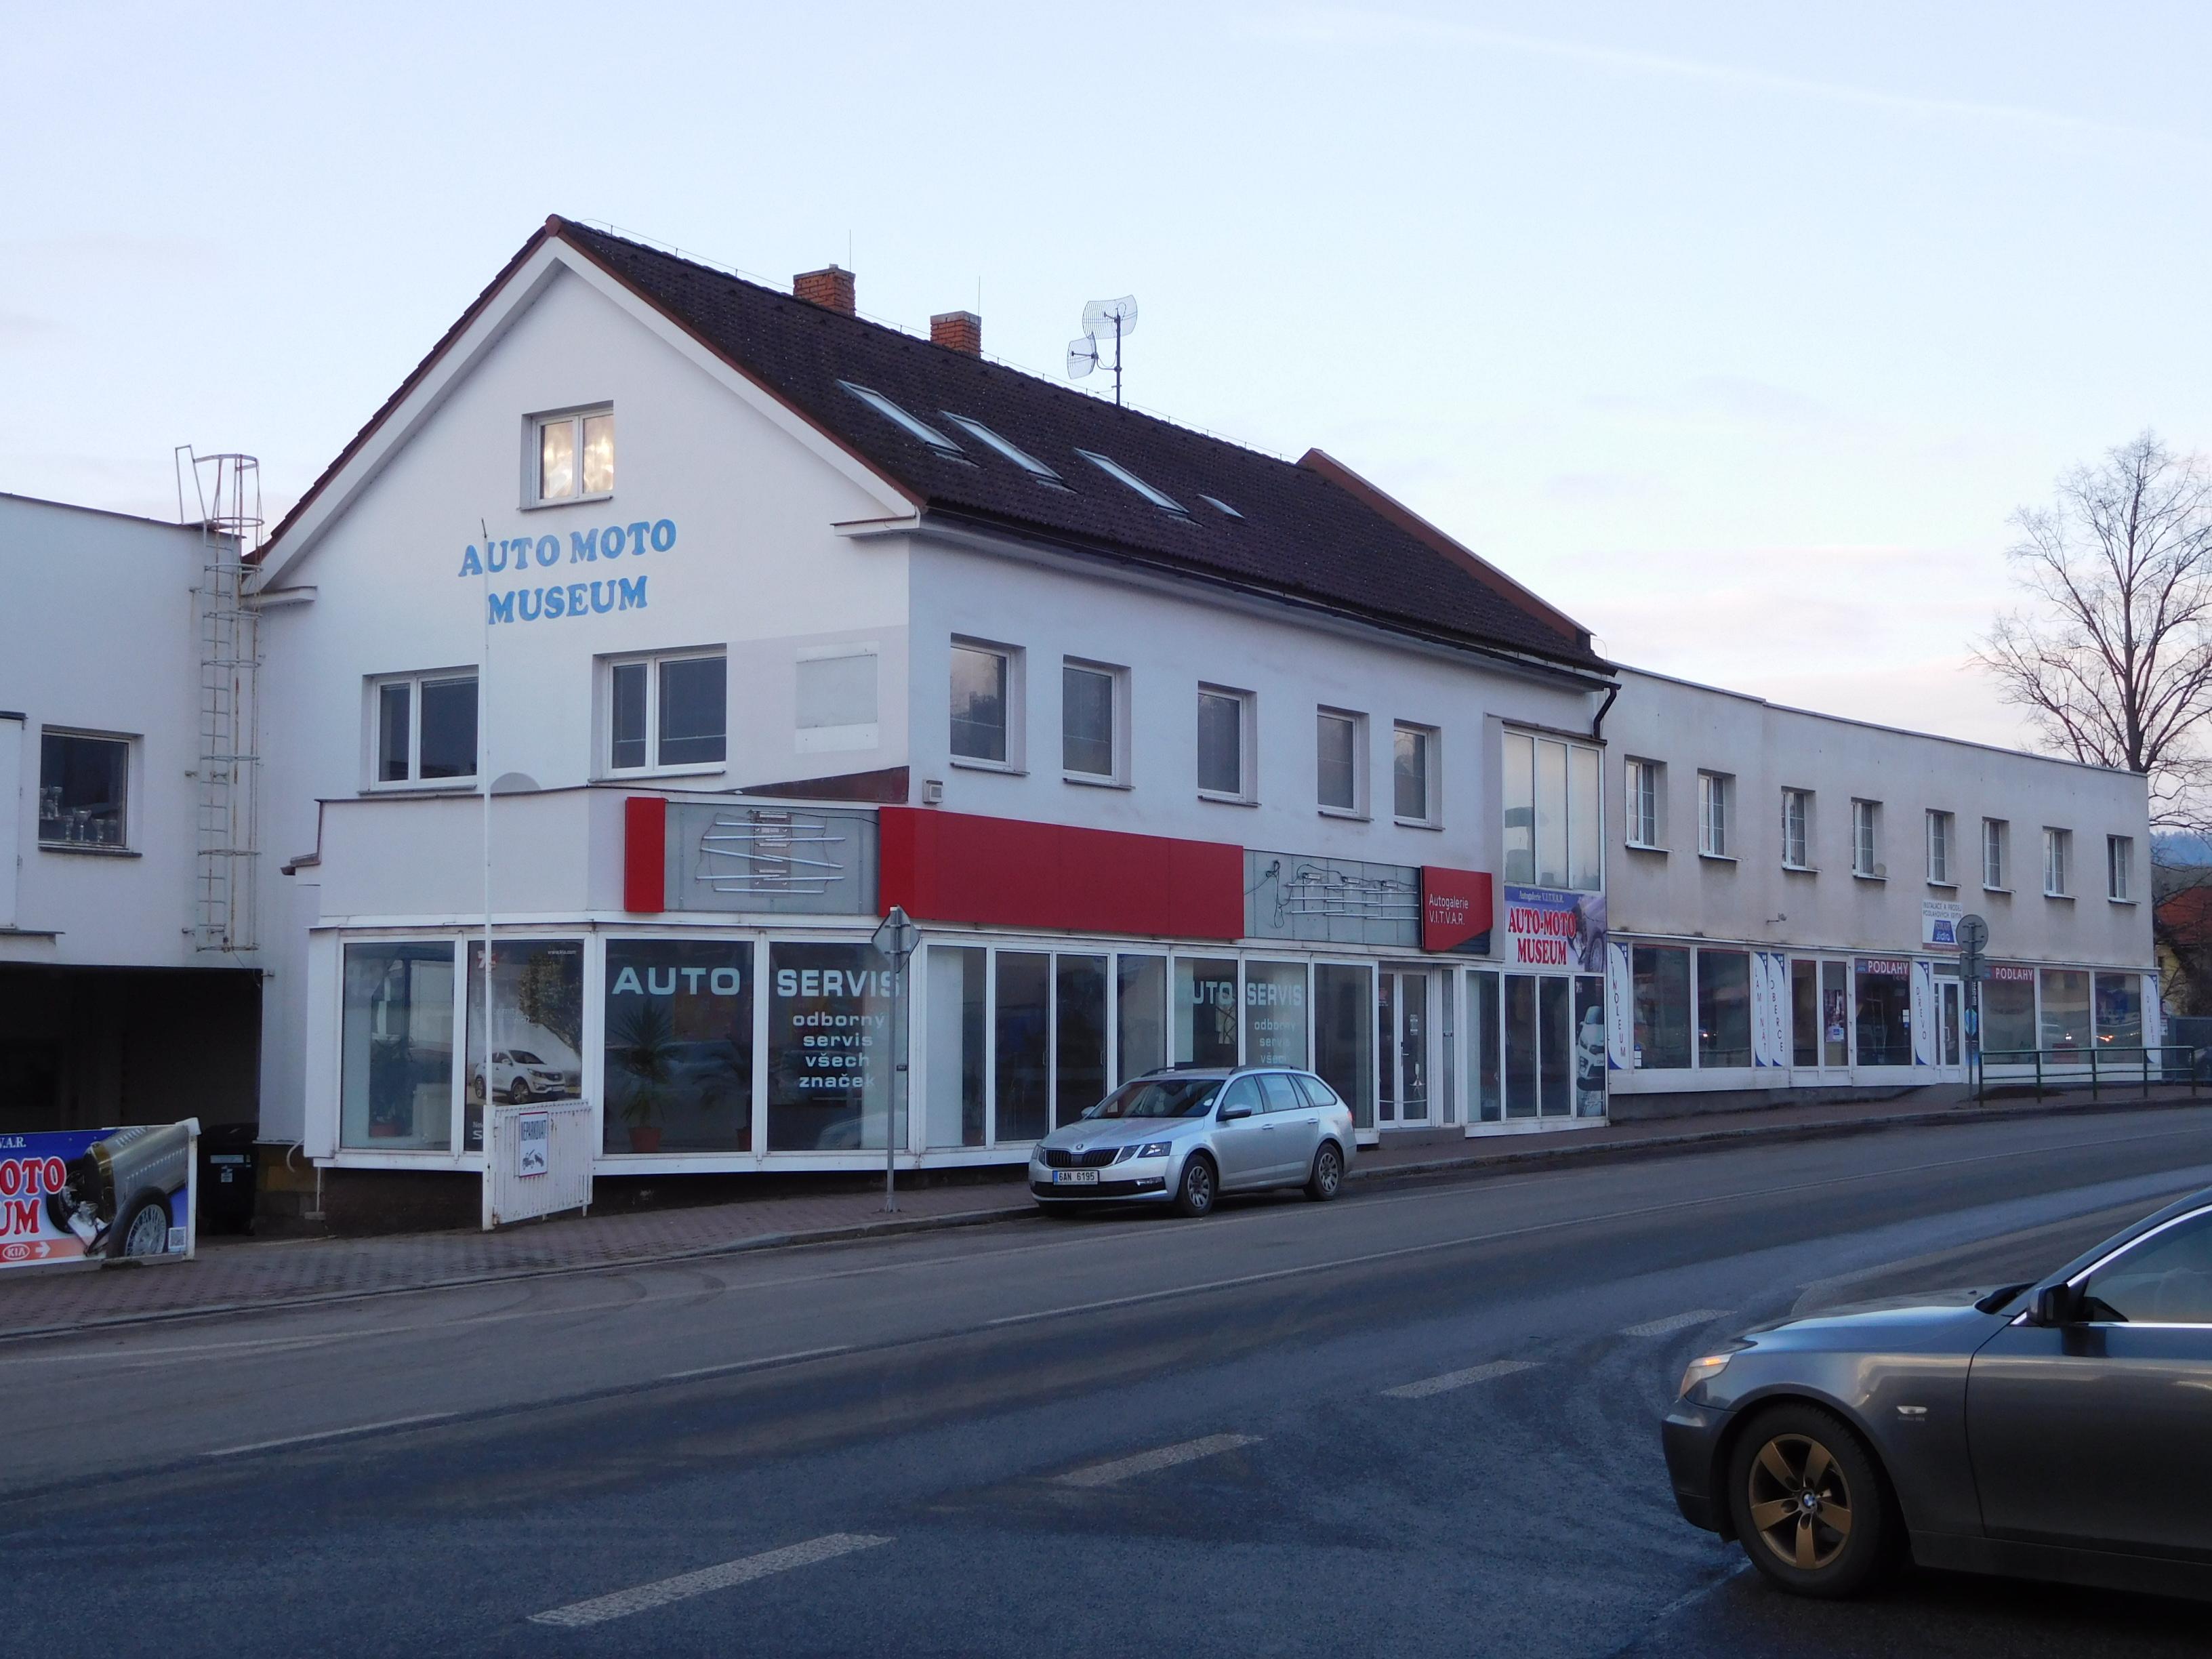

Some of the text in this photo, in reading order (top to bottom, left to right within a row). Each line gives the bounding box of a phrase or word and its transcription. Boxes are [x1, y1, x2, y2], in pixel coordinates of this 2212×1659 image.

[458, 519, 676, 577] AUTO MOTO
[489, 575, 648, 625] MUSEUM
[1429, 893, 1469, 910] Autogalerie
[1429, 910, 1465, 925] V.I.T.V.A.R.
[1508, 907, 1576, 938] AUTO-MOTO
[1517, 937, 1567, 966] MUSEUM
[1868, 960, 1909, 975] PODLAHY
[1995, 968, 2033, 981] PODLAHY
[611, 967, 900, 998] AUTO SERVIS
[1193, 981, 1302, 1006] UTO SERVIS
[1769, 961, 1784, 1052] OBERCE
[792, 1012, 885, 1029] odborný
[803, 1033, 874, 1047] servis
[806, 1052, 869, 1067] všech
[799, 1073, 876, 1088] značek
[1059, 1172, 1095, 1181] 6AN 6195
[7, 1247, 26, 1257] KIA
